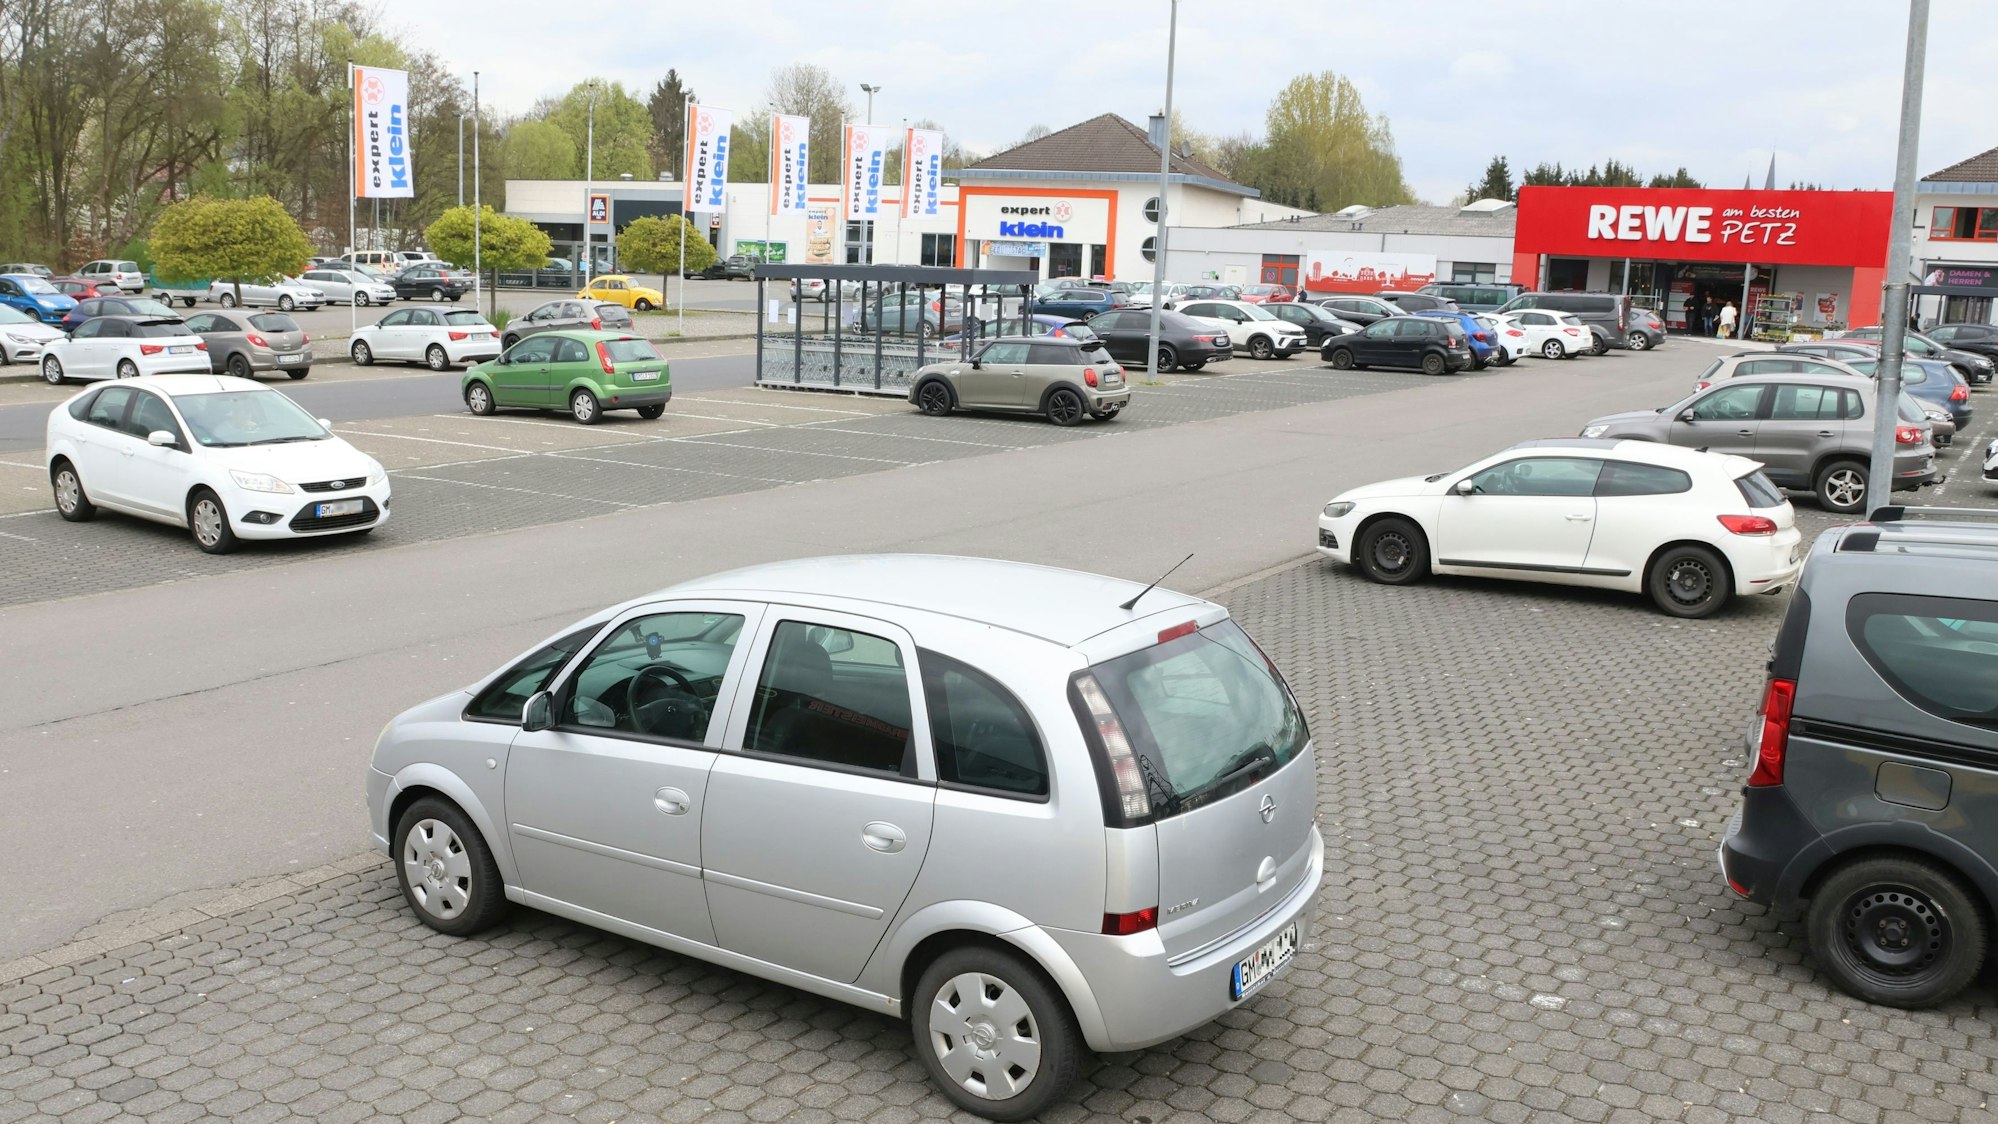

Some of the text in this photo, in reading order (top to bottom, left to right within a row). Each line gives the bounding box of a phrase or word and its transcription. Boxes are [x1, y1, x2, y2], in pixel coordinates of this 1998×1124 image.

[368, 111, 381, 188] expert
[387, 104, 408, 188] klein
[695, 140, 708, 204] expert
[709, 136, 727, 206] klein
[784, 148, 792, 208] expert
[795, 143, 806, 209] klein
[853, 156, 863, 213] expert
[865, 150, 882, 213] klein
[913, 160, 922, 213] expert
[925, 155, 938, 214] klein
[1000, 221, 1064, 239] klein
[1001, 206, 1051, 216] expert
[1587, 204, 1713, 242] REWE
[1720, 220, 1797, 245] PETZ
[1722, 205, 1799, 218] am besten
